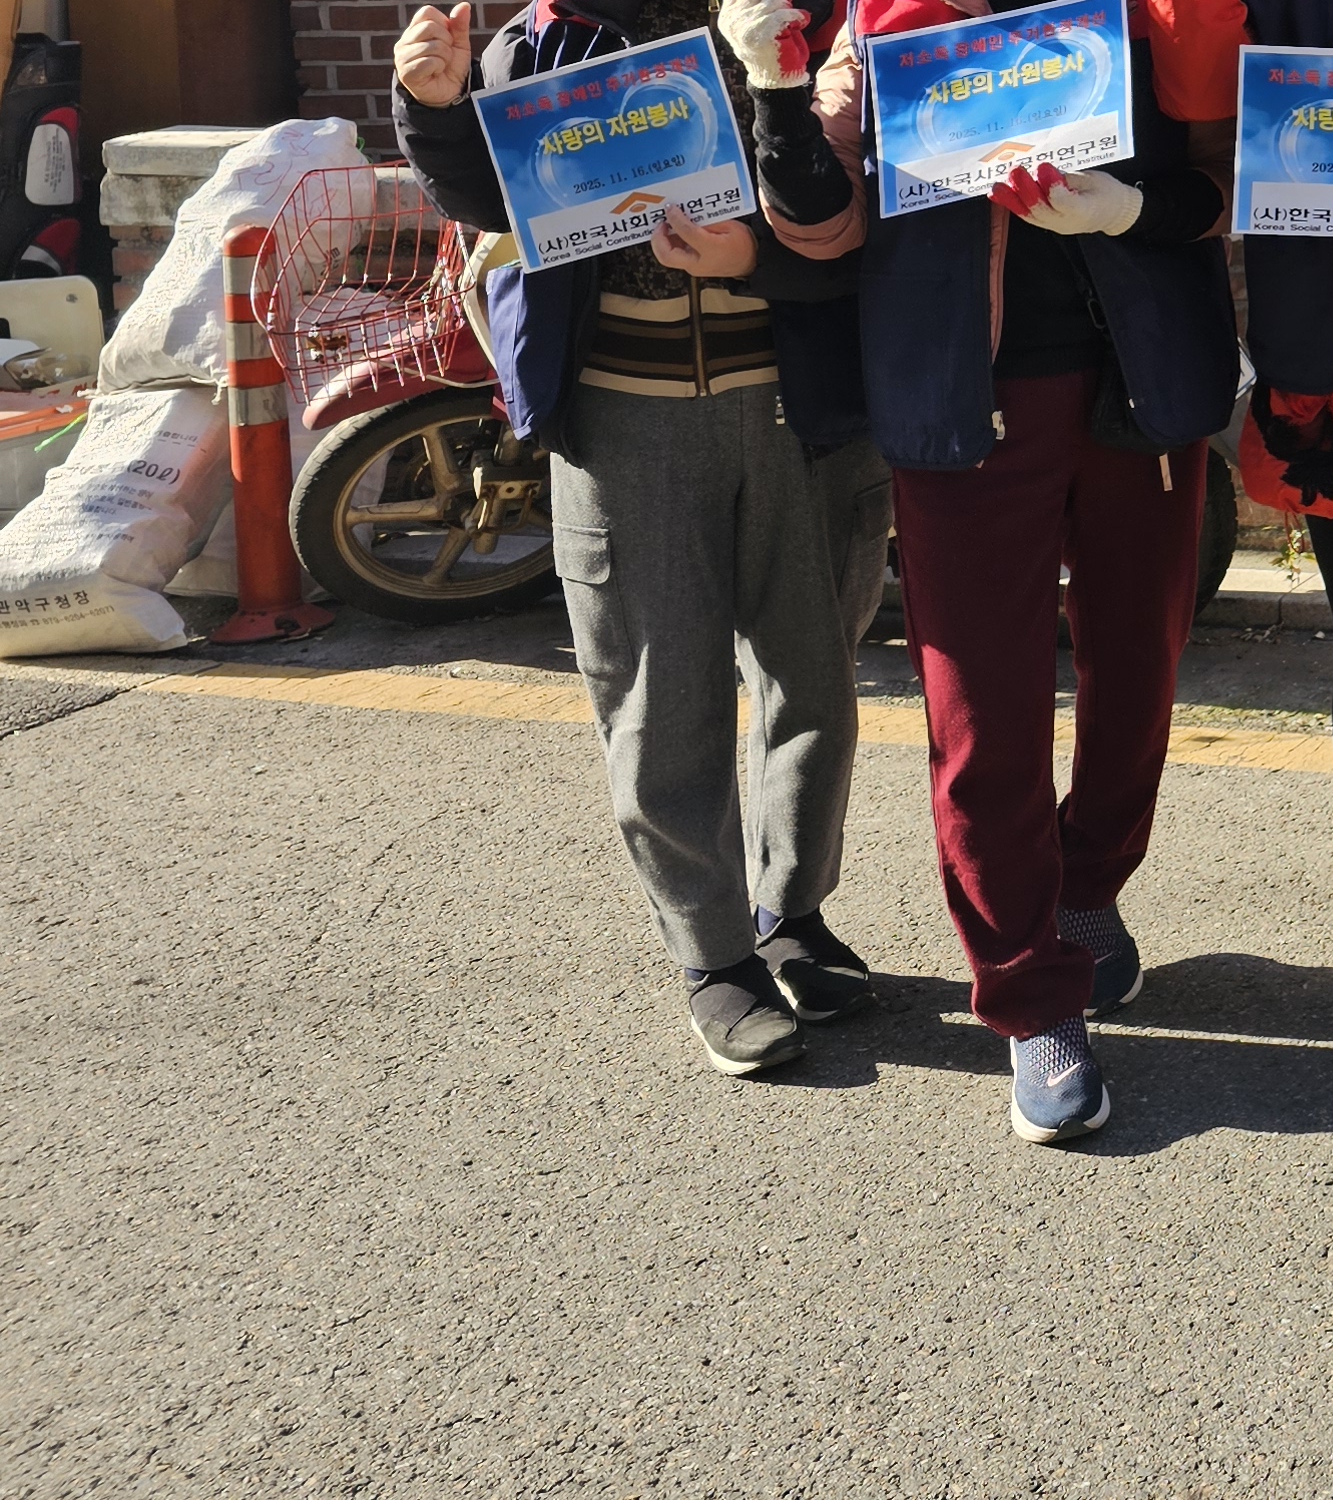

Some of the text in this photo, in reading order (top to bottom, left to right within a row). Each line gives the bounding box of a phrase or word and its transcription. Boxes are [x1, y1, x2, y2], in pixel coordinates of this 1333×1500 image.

[926, 48, 1084, 107] 사랑의 자원봉사
[537, 95, 691, 159] 사랑의 자원봉사
[572, 176, 605, 195] 2025.
[607, 170, 626, 185] 11.
[900, 197, 929, 211] Korea
[934, 188, 962, 202] Social
[1077, 150, 1114, 166] Institute
[542, 250, 571, 264] Korea
[574, 241, 603, 256] Social
[706, 203, 740, 219] Institute
[1253, 222, 1284, 231] Korea
[1290, 223, 1320, 232] Social
